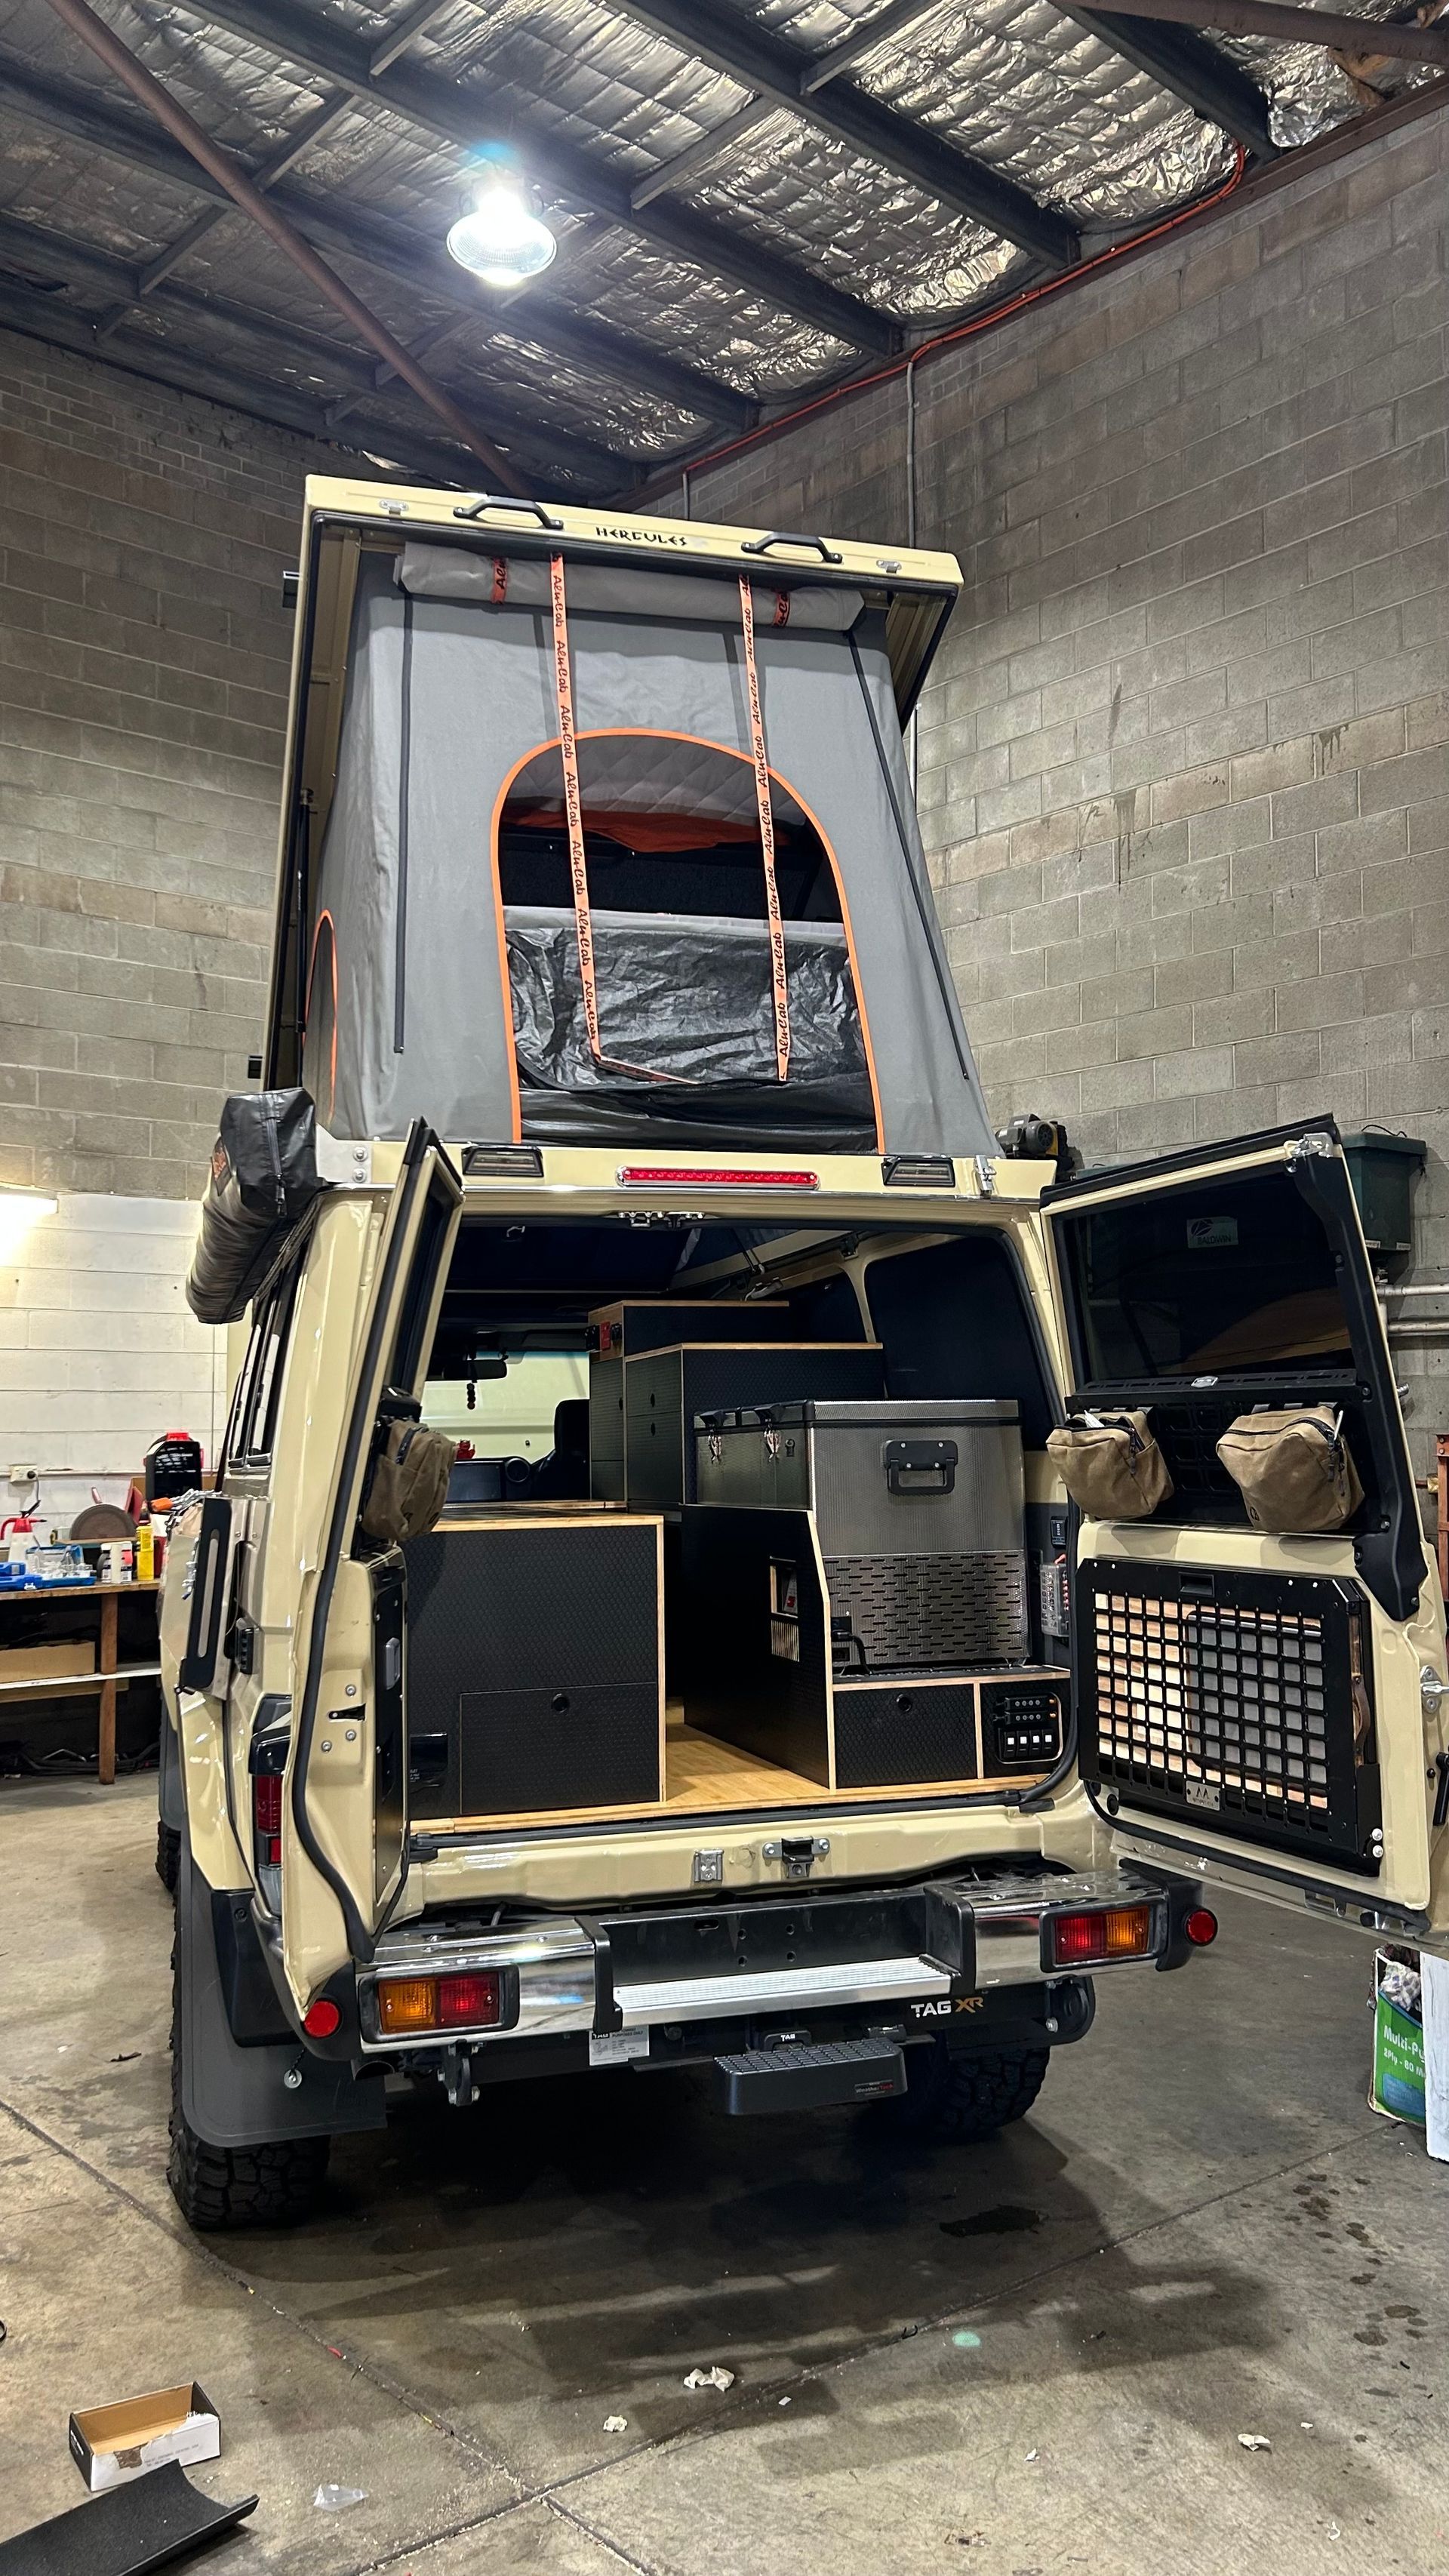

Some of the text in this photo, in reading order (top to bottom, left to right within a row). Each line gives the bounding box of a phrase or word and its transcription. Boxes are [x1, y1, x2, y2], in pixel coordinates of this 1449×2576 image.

[595, 526, 688, 546] HERCULES
[1197, 1233, 1232, 1245] BALDWIN
[910, 1996, 984, 2018] TAG XR
